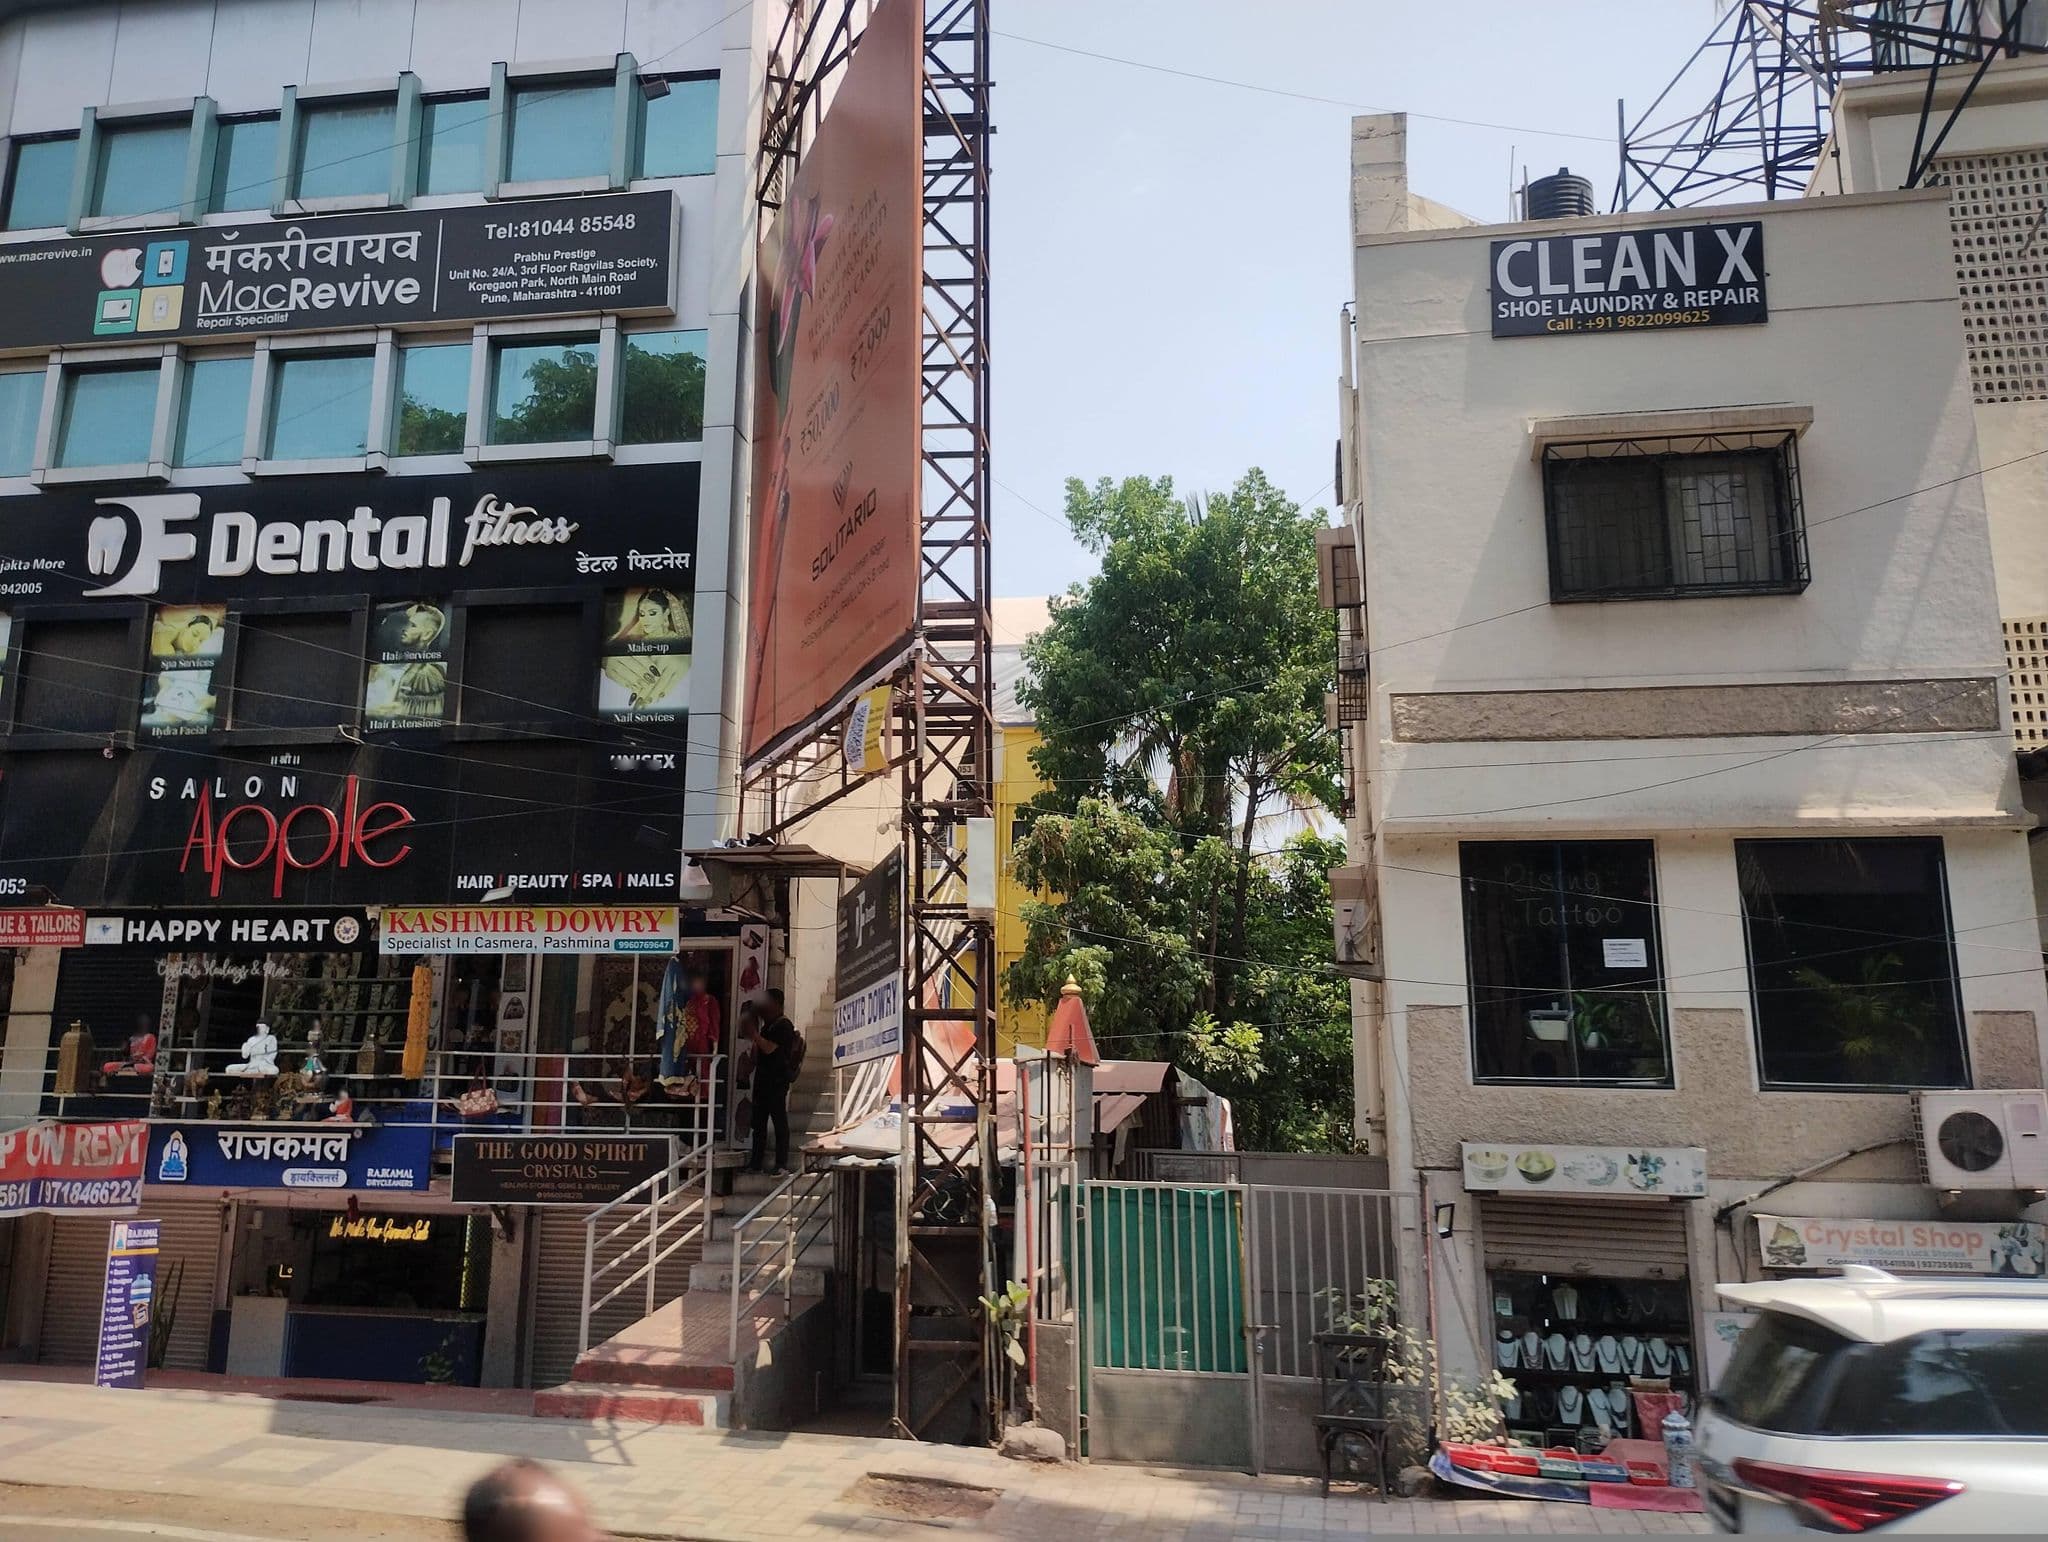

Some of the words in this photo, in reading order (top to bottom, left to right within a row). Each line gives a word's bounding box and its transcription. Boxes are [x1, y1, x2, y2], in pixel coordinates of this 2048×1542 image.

[484, 218, 574, 239] Tel:81044
[580, 214, 636, 232] 85548
[514, 252, 550, 263] Prabhu
[553, 249, 596, 261] Prestige
[1496, 231, 1697, 297] CLEAN
[1714, 227, 1759, 284] X
[449, 270, 470, 280] Unit
[472, 269, 490, 279] No.
[520, 265, 537, 275] 3rd
[540, 263, 567, 275] Floor
[570, 260, 614, 274] Ragvilas
[616, 257, 658, 269] Society,
[468, 280, 518, 292] Koregaon
[521, 278, 547, 289] Park,
[550, 276, 579, 286] North
[581, 273, 606, 284] Main
[609, 271, 637, 281] Road
[198, 273, 420, 312] MacRevive
[480, 293, 510, 304] Pune,
[513, 289, 577, 302] Maharashtra
[586, 284, 621, 297] 411001
[1497, 300, 1553, 319] SHOE
[1558, 292, 1658, 315] LAUNDRY
[1662, 293, 1679, 310] &
[1683, 287, 1760, 307] REPAIR
[197, 316, 232, 329] Repair
[235, 312, 289, 327] Specialist
[1547, 318, 1574, 331] Call
[1585, 316, 1613, 330] +91
[1617, 310, 1710, 328] 9822099625
[208, 496, 450, 577] Dental
[459, 493, 580, 567] fitness
[812, 488, 876, 581] SOLITARIO
[33, 558, 65, 569] More
[0, 582, 43, 594] 942005
[627, 642, 670, 655] Make-up
[370, 720, 389, 730] Hair
[634, 712, 675, 723] Services
[152, 726, 178, 738] Hydra
[180, 725, 208, 736] Facial
[149, 775, 297, 800] SALON
[180, 774, 415, 898] Apple
[457, 875, 494, 889] HAIR
[507, 873, 569, 888] BEAUTY
[582, 874, 613, 888] SPA
[627, 873, 675, 887] NAILS
[388, 909, 538, 934] KASHMIR
[544, 909, 666, 933] DOWRY
[1512, 897, 1624, 928] Tattoo
[18, 915, 26, 933] &
[30, 914, 80, 933] TAILORS
[127, 920, 221, 943] HAPPY
[231, 919, 331, 943] HEART
[387, 936, 452, 952] Specialist
[457, 937, 469, 949] In
[474, 937, 538, 950] Casmera,
[543, 936, 611, 949] Pashmina
[868, 979, 897, 1024] DOWRY
[0, 1134, 16, 1169] P
[26, 1125, 67, 1167] ON
[72, 1123, 147, 1167] RENT
[218, 1131, 352, 1161] राजकमल
[475, 1142, 514, 1160] THE
[520, 1142, 577, 1161] GOOD
[583, 1143, 648, 1161] SPIRIT
[367, 1168, 414, 1179] RAJKAMAL
[523, 1164, 597, 1179] CRYSTALS
[1804, 1223, 1905, 1251] Crystal
[1913, 1226, 1984, 1255] Shop
